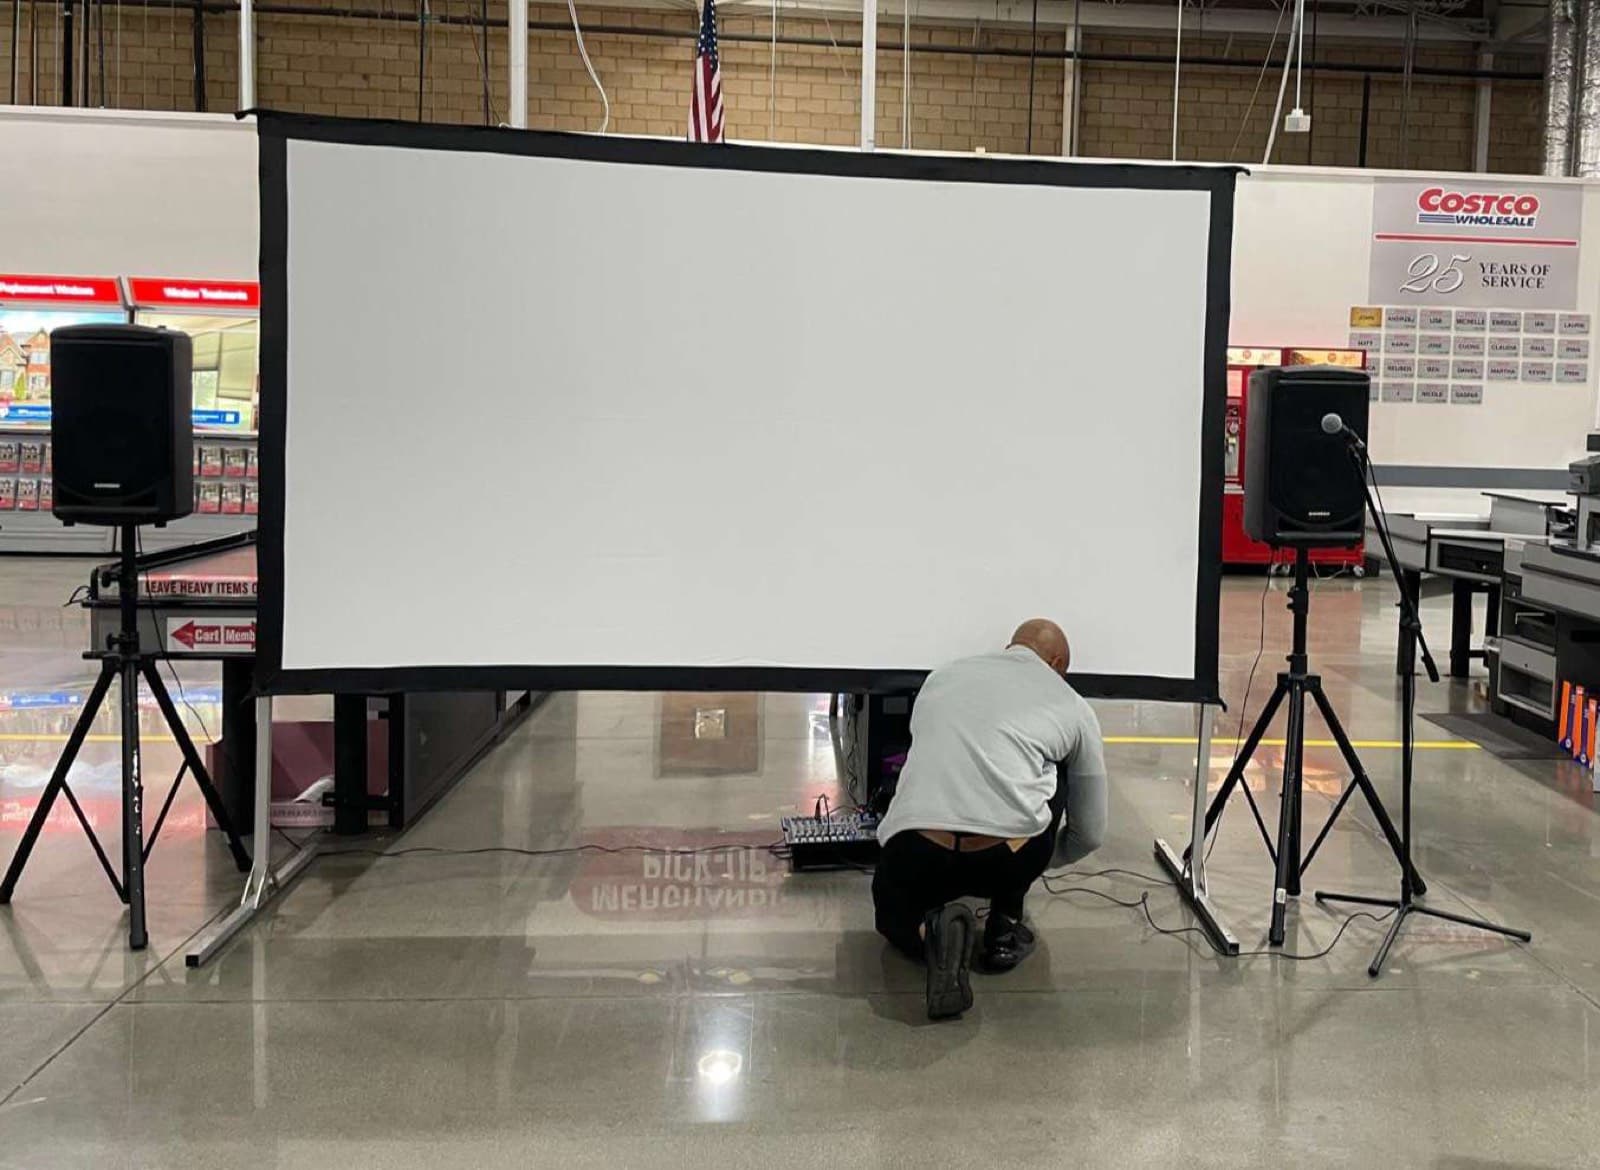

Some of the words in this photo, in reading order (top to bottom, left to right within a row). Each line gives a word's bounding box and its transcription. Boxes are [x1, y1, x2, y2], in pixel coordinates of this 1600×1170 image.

[1418, 188, 1539, 216] COSTCO
[1455, 215, 1536, 227] WHOLESALE
[1400, 252, 1471, 294] 25
[1479, 262, 1527, 276] YEARS
[1530, 264, 1552, 277] OF
[1481, 275, 1545, 289] SERVICE
[145, 580, 177, 594] LEAVE
[179, 580, 213, 594] HEAVY
[217, 581, 248, 594] ITEMS
[195, 629, 220, 643] Cart
[226, 629, 256, 643] Memb
